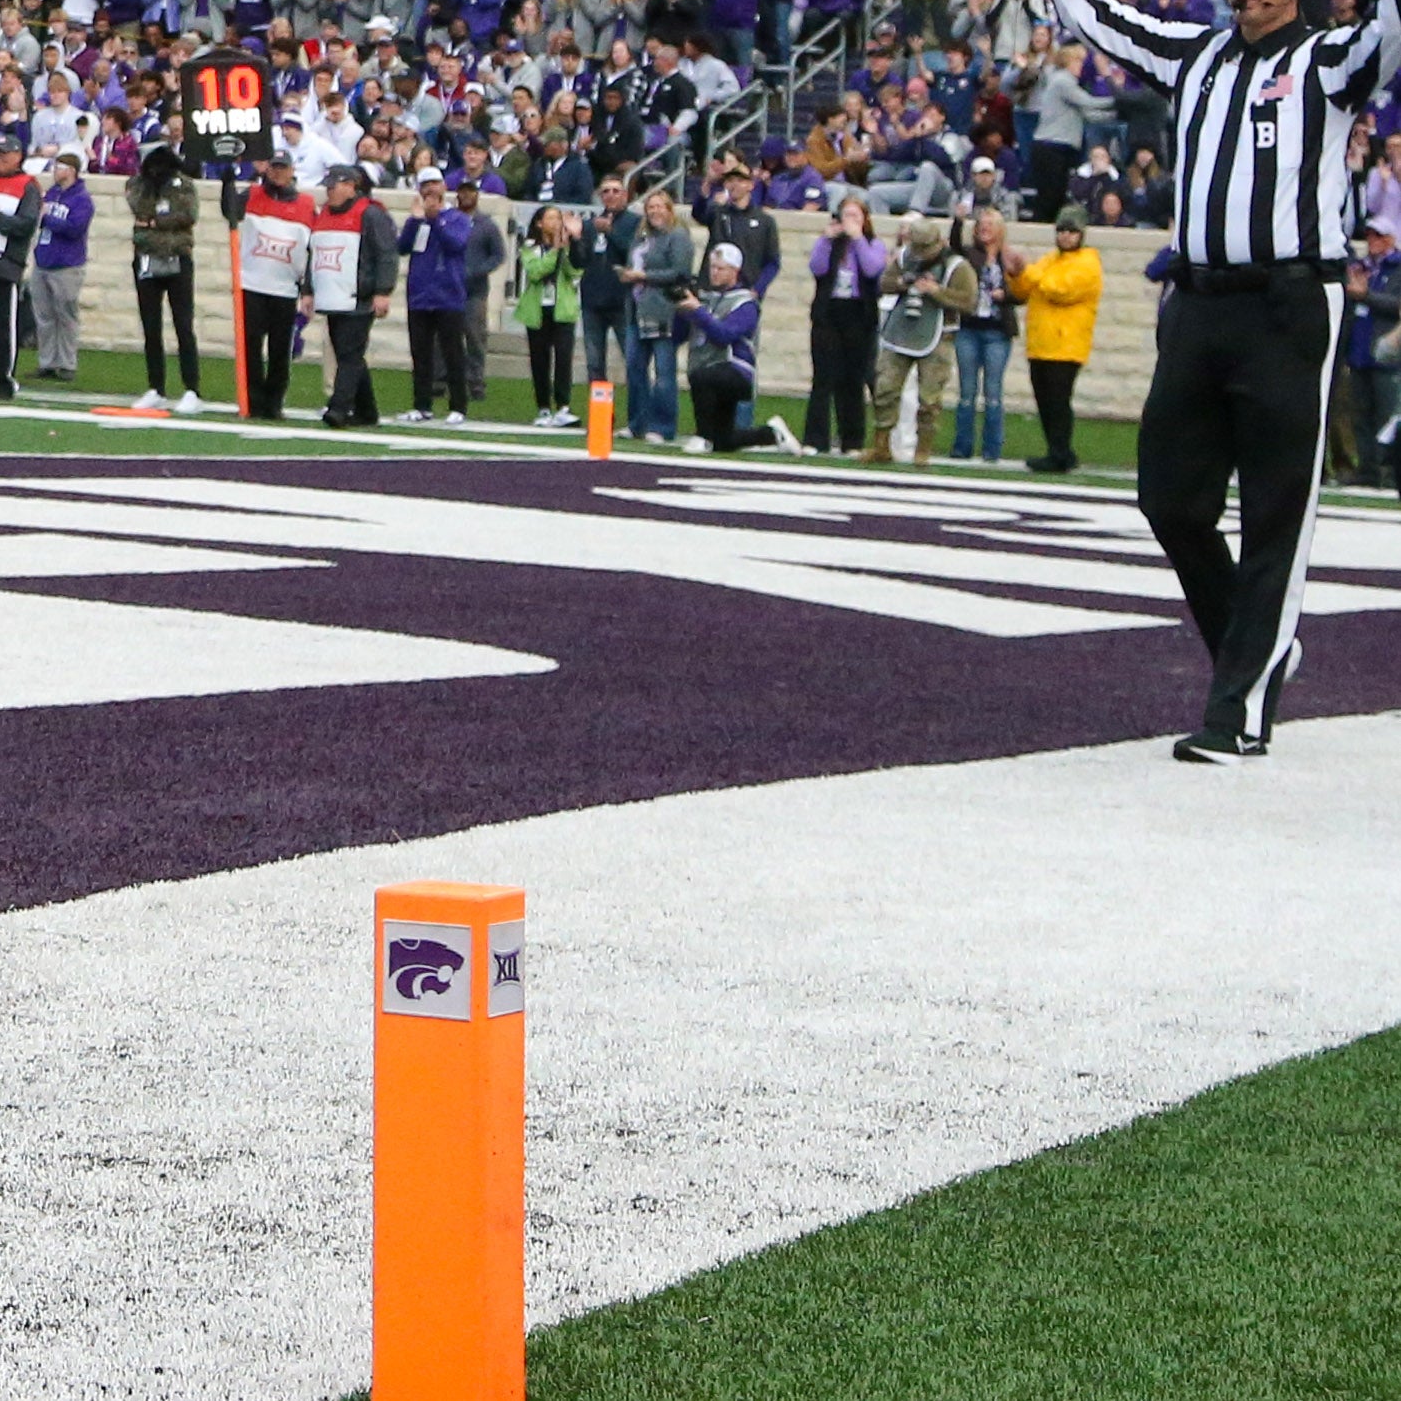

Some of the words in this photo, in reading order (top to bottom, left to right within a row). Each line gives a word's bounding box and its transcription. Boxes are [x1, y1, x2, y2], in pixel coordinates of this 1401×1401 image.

[196, 65, 263, 111] 10
[192, 107, 262, 135] YARD
[1255, 121, 1278, 149] B
[493, 947, 521, 987] XII
